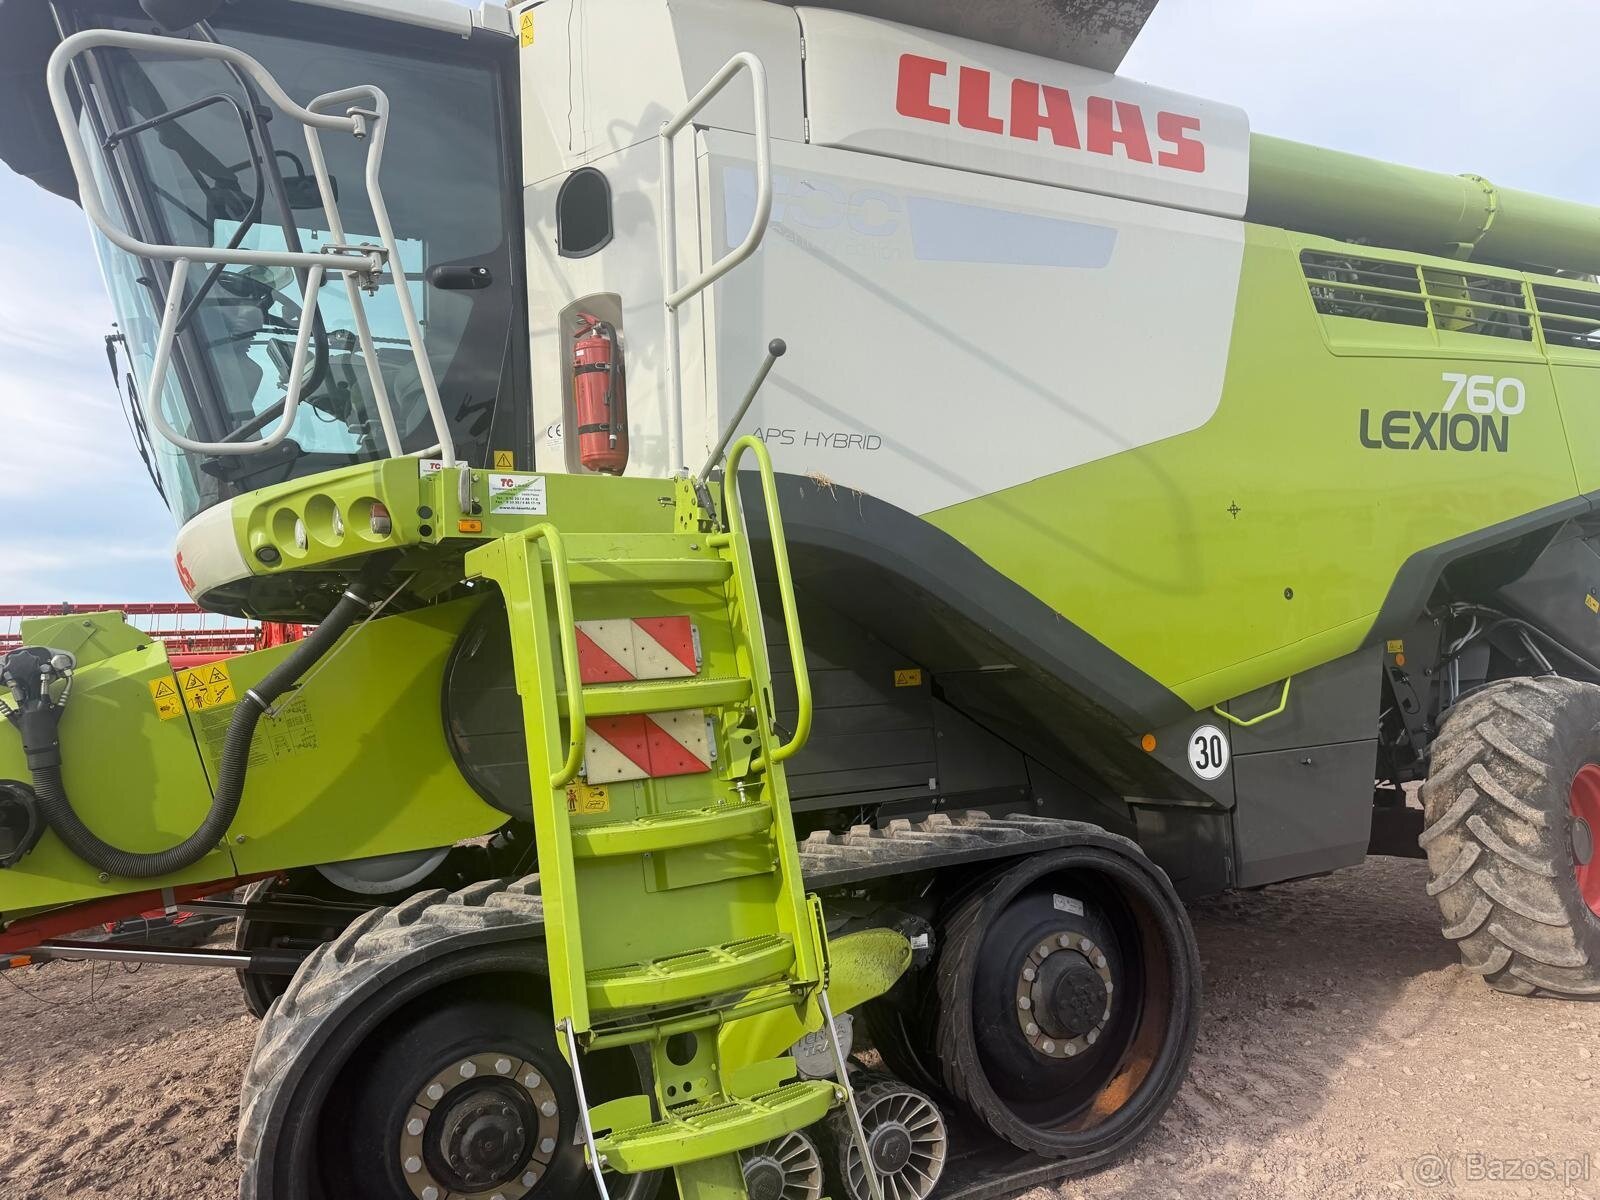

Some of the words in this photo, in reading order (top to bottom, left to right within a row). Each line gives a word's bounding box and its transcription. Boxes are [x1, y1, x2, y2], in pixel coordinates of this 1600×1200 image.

[896, 53, 1205, 173] CLAAS
[1442, 372, 1526, 415] 760
[752, 427, 797, 446] APS
[803, 430, 883, 451] HYBRID
[1360, 408, 1509, 453] LEXION
[429, 462, 441, 470] TC
[500, 478, 514, 488] TC
[1194, 735, 1223, 770] 30
